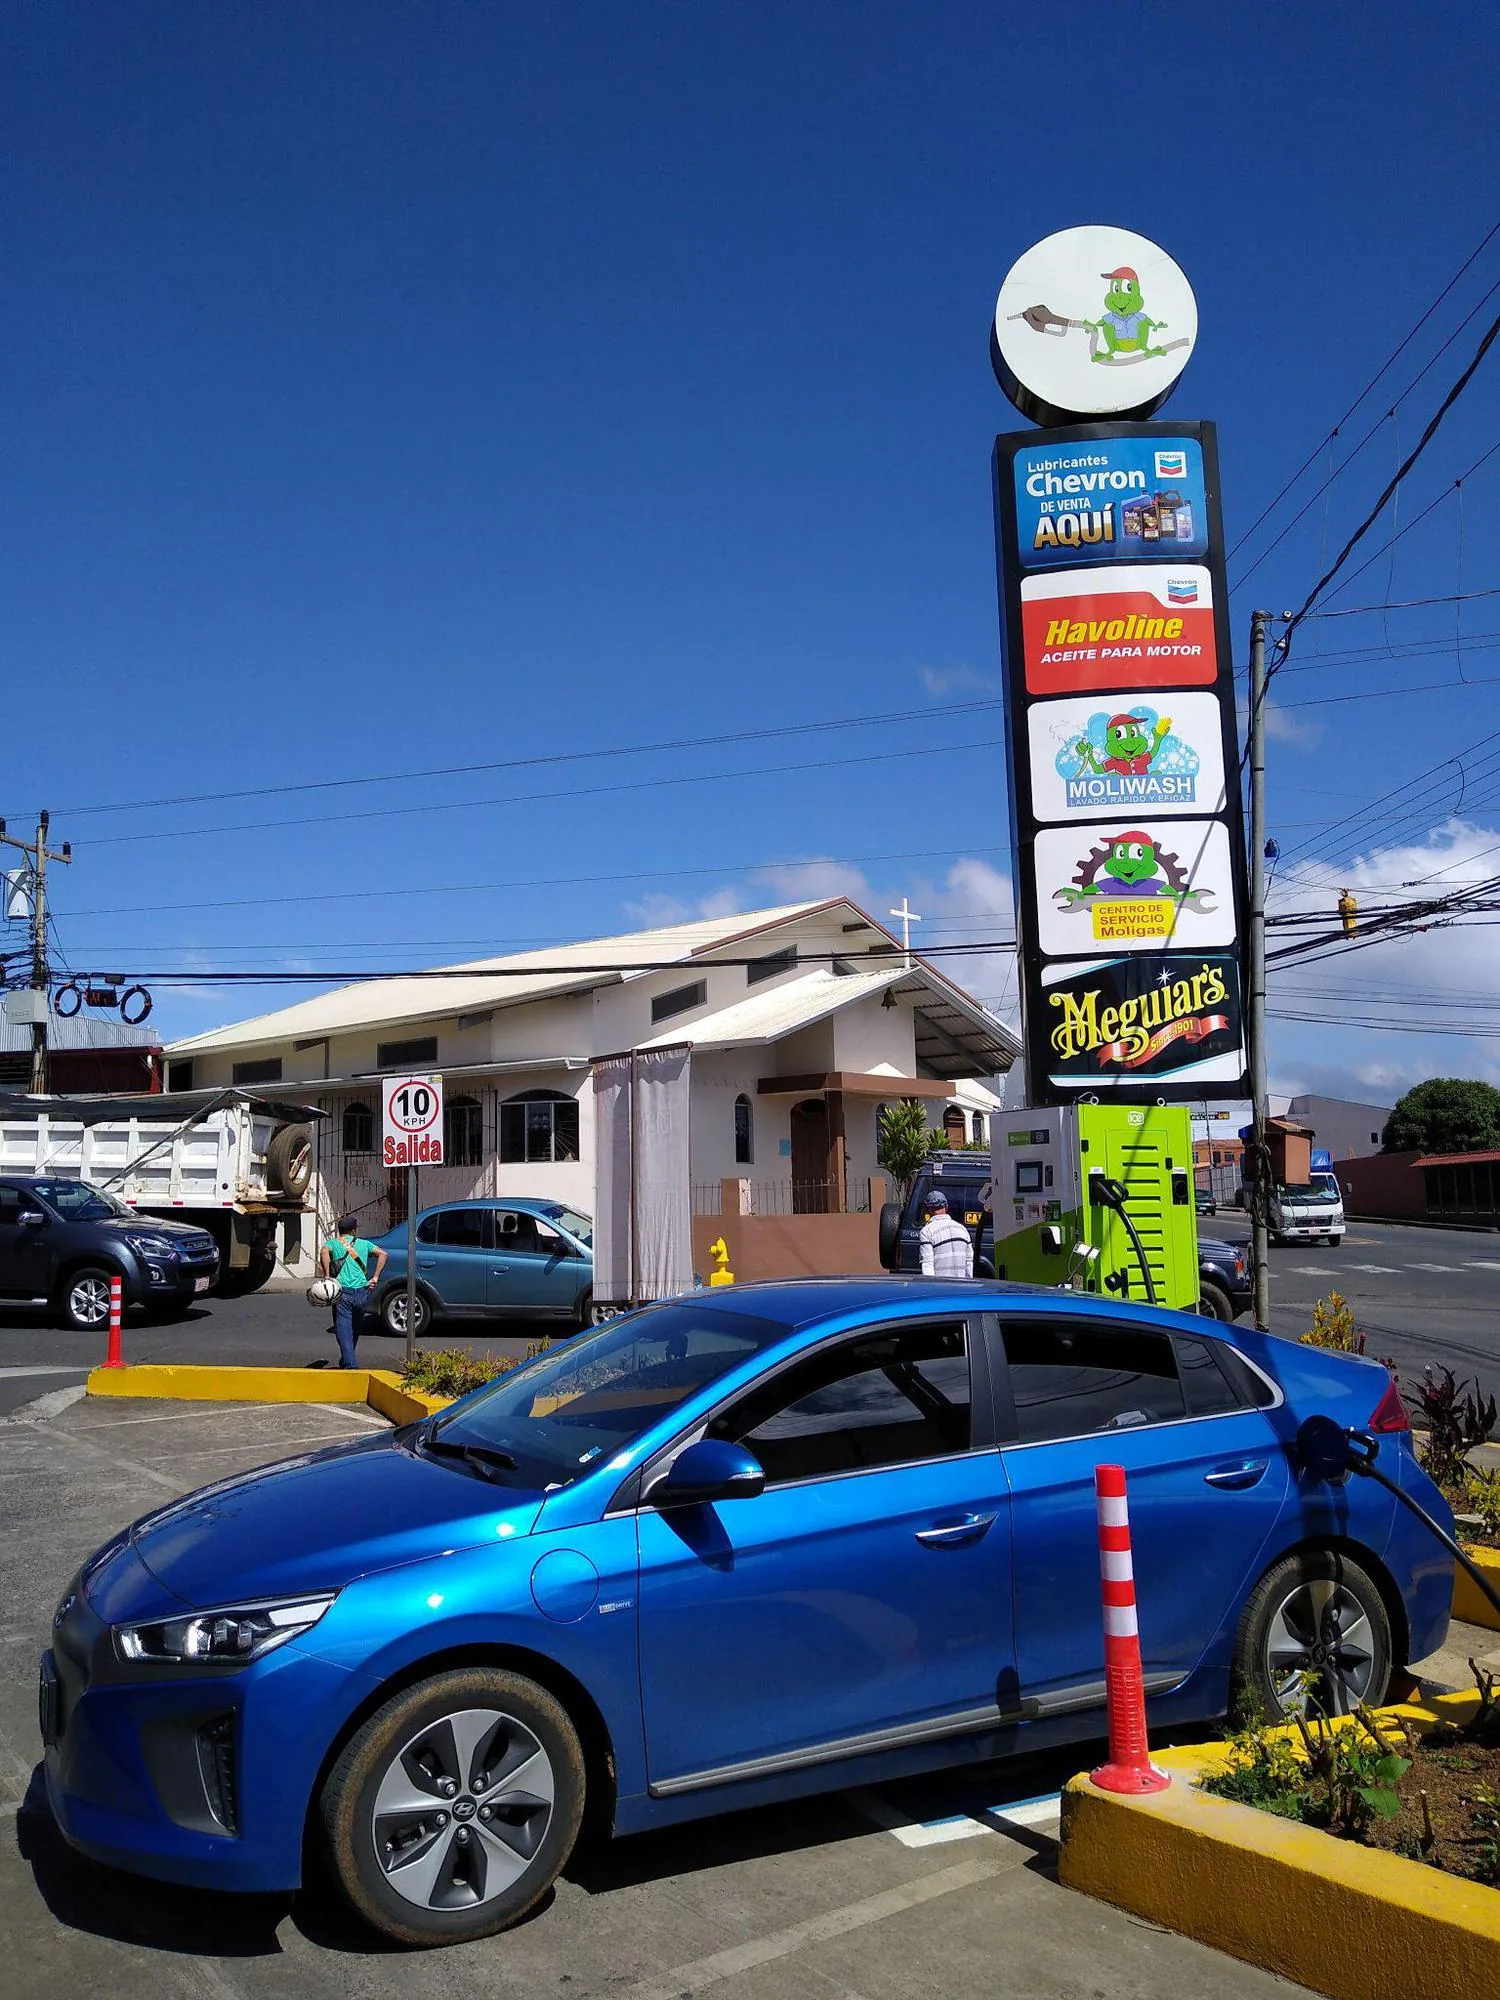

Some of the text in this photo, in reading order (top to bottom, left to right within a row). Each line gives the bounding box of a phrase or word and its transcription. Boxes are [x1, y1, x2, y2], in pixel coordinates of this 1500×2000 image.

[1028, 455, 1108, 472] Lubricantes
[1026, 470, 1145, 497] Chevron
[1040, 497, 1092, 514] DE VENTA
[1033, 502, 1115, 550] AQUÍ
[1045, 613, 1184, 646] Havoline
[1040, 644, 1203, 664] ACEITE PARA MOTOR
[1069, 776, 1192, 798] MOLIWASH
[1070, 797, 1108, 807] LAVADO
[1158, 794, 1191, 802] EFICAZ
[1099, 904, 1164, 915] CENTRO DE
[1100, 914, 1165, 925] SERVICIO
[1101, 926, 1165, 938] Moligas
[1049, 963, 1225, 1062] Meguiar's
[1150, 1019, 1194, 1052] Since 1901
[397, 1089, 429, 1116] 10
[403, 1117, 426, 1126] KPH
[384, 1134, 441, 1164] Salida
